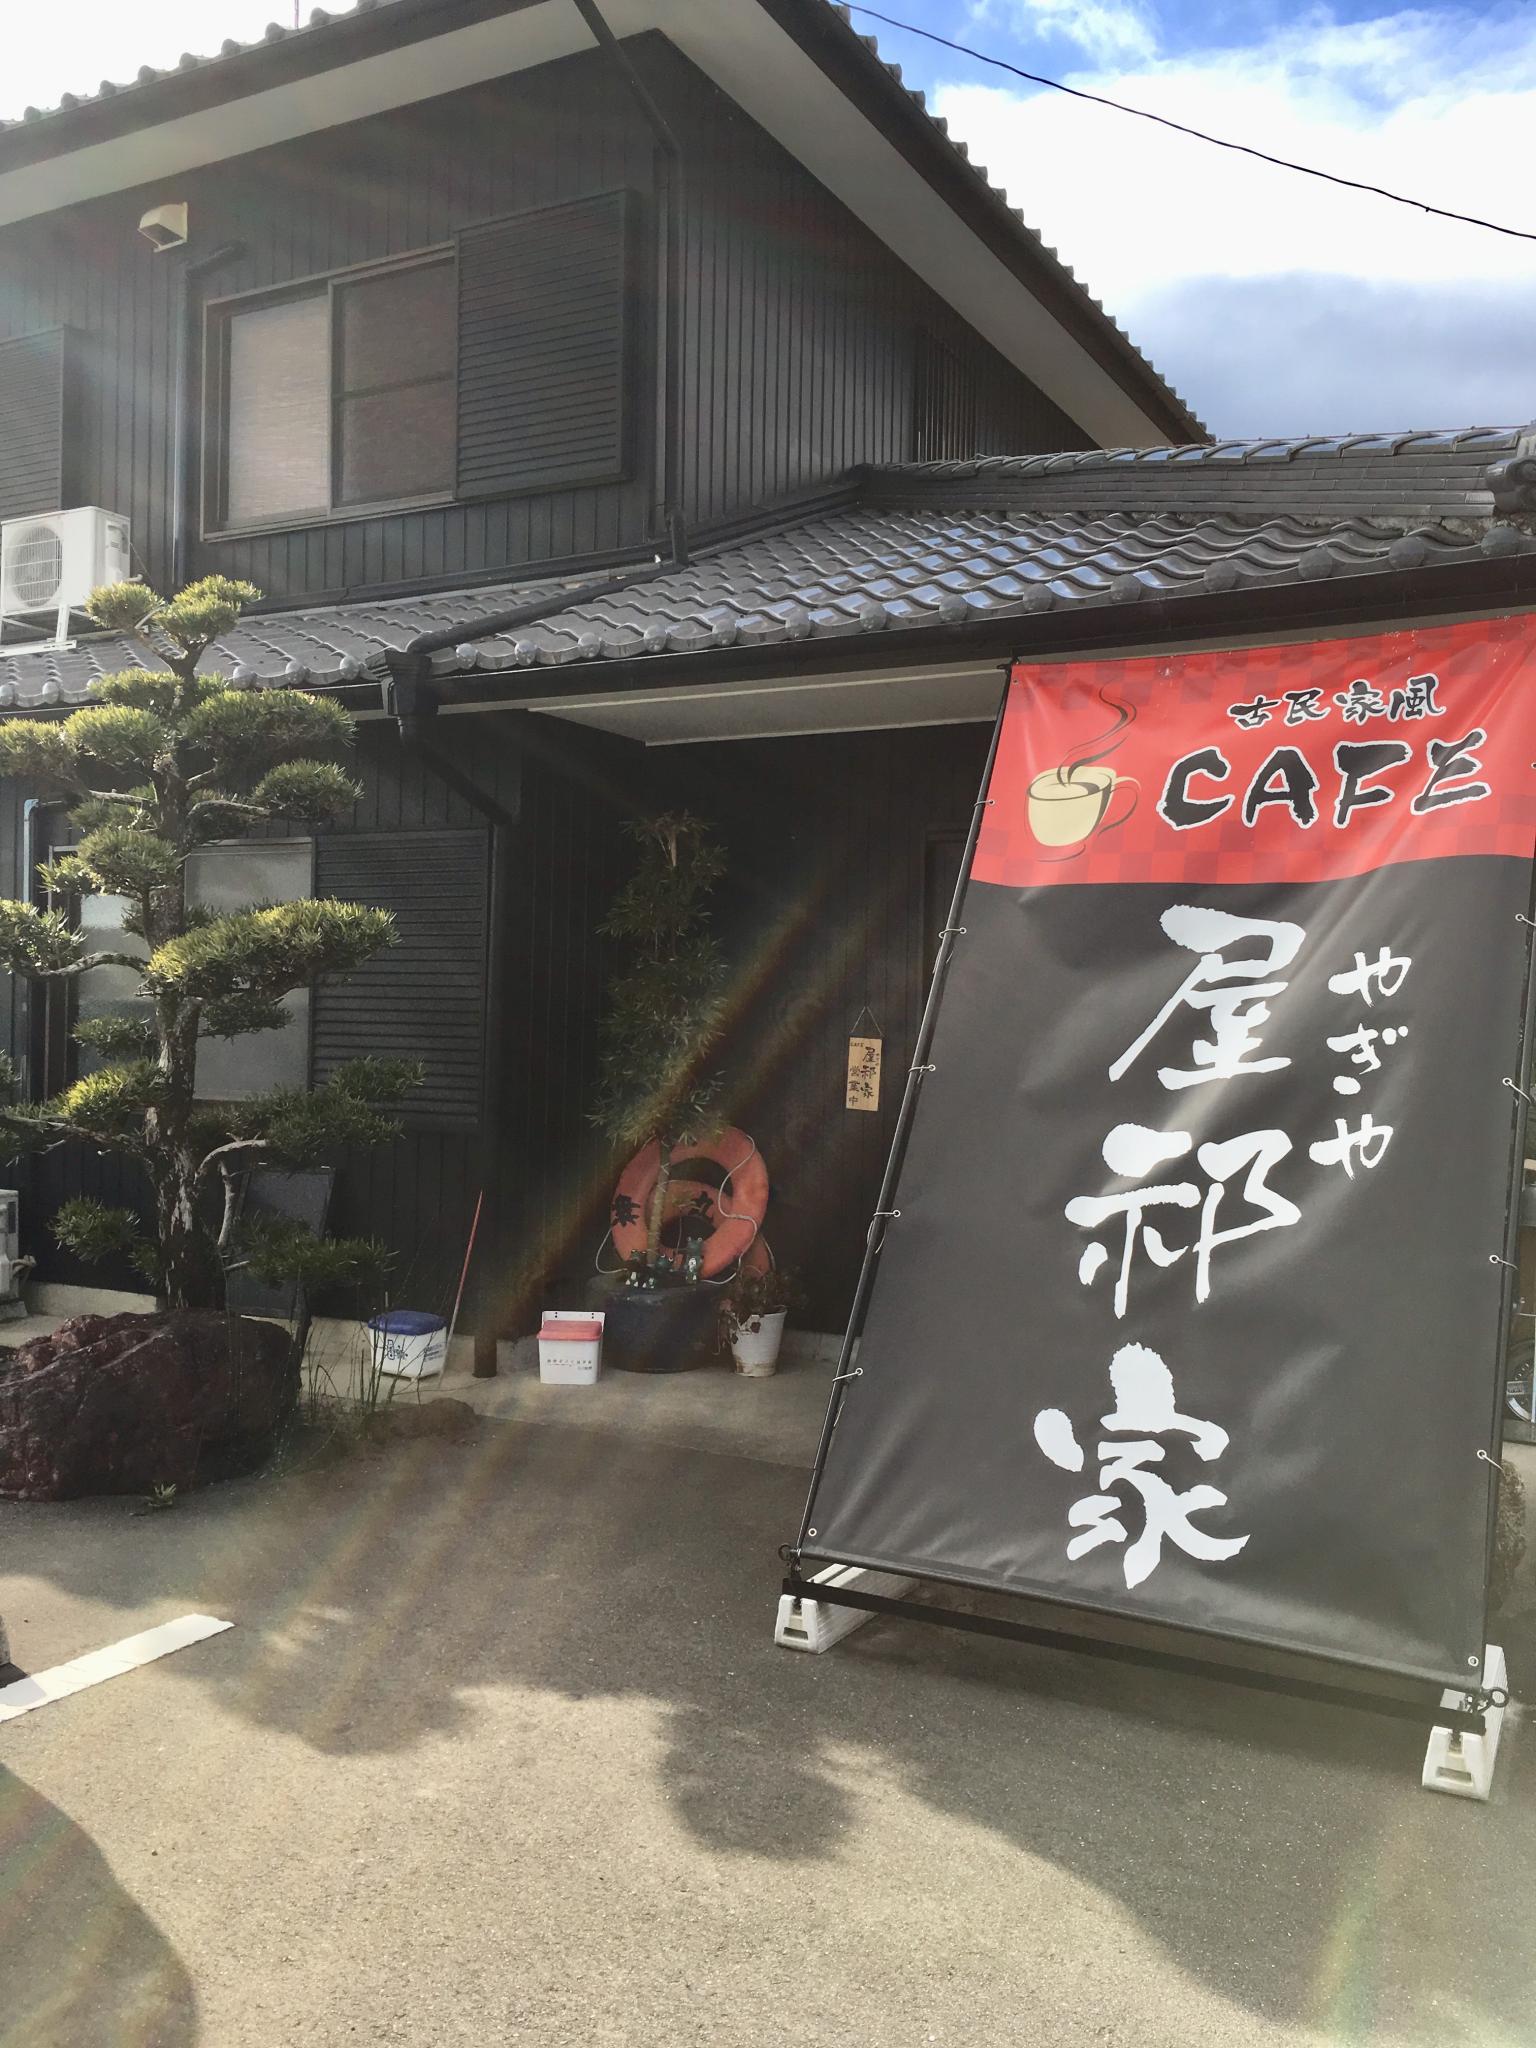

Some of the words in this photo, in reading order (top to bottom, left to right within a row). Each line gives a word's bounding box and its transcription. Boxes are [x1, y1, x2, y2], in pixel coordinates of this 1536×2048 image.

[1226, 673, 1446, 730] 古民家風
[1156, 728, 1492, 830] CAFE
[1309, 947, 1411, 1180] やぎや
